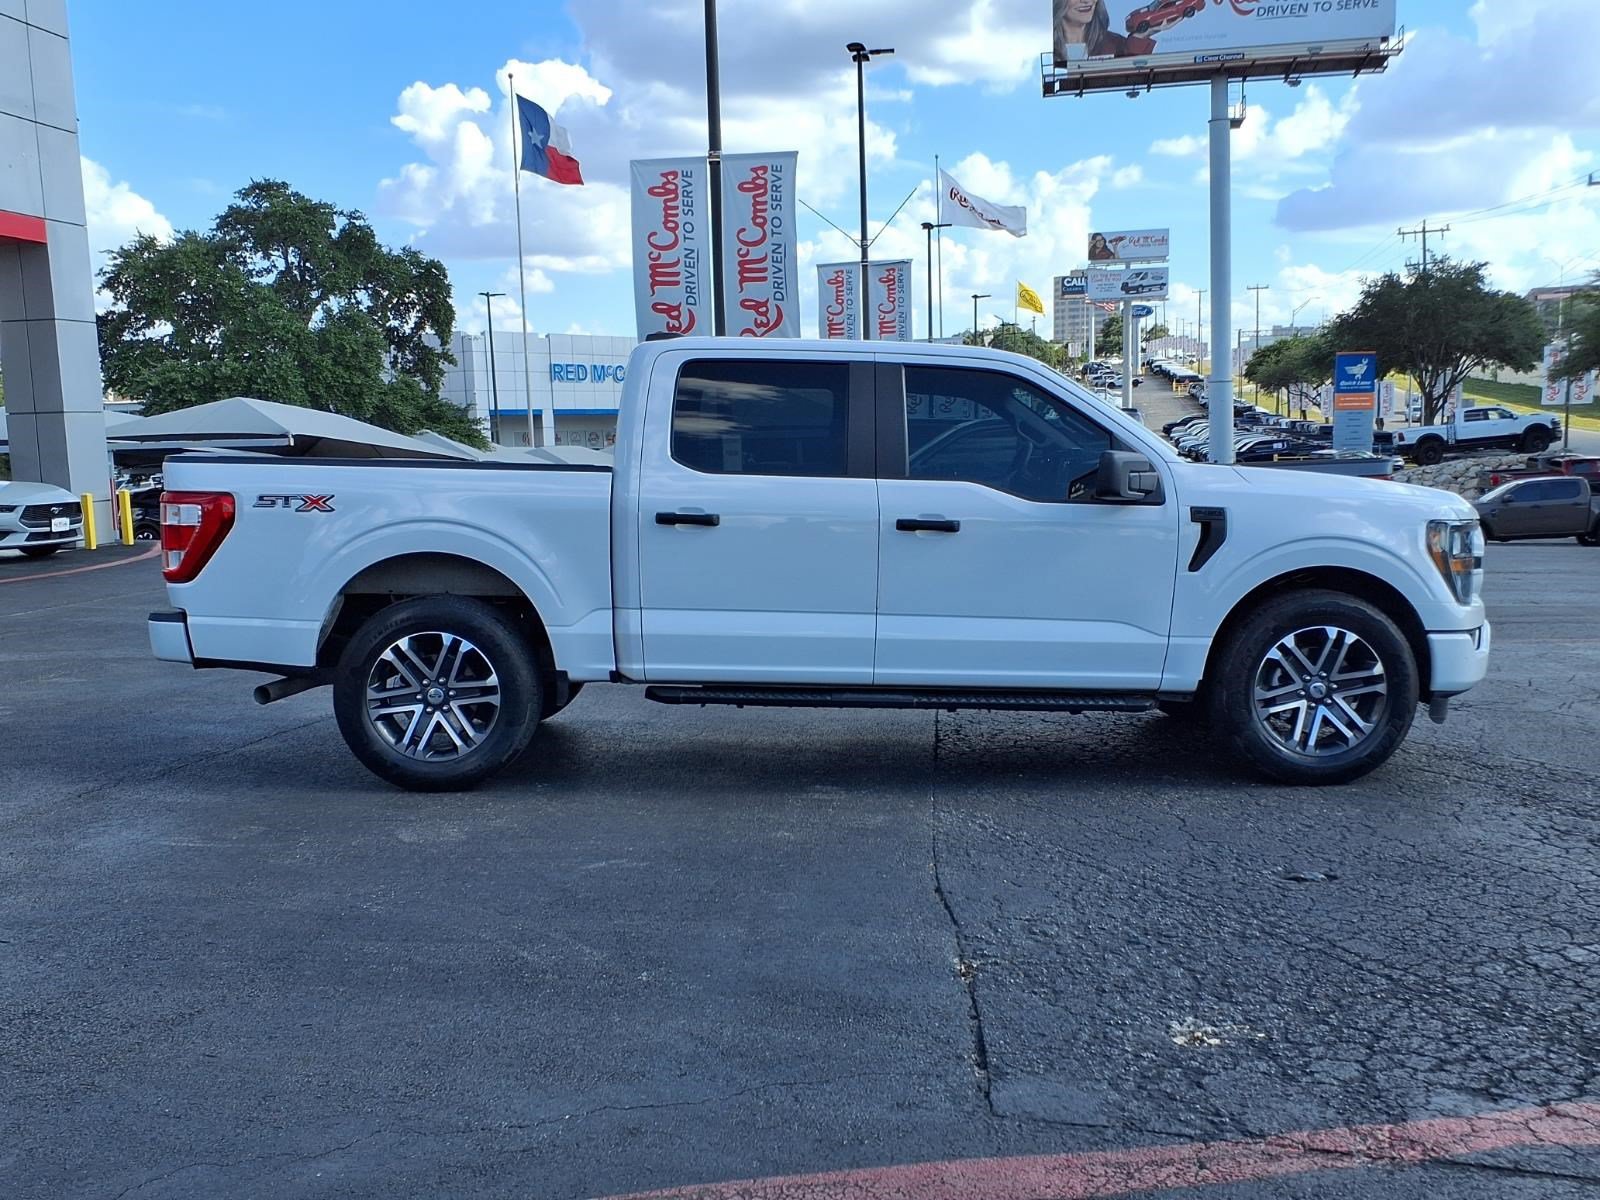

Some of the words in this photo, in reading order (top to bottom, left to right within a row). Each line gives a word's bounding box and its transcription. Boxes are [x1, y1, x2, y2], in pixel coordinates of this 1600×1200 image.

[1256, 2, 1309, 17] DRIVEN
[1314, 1, 1332, 13] TO
[1337, 0, 1379, 11] SERVE
[681, 170, 694, 217] SERVE
[770, 164, 782, 212] SERVE
[647, 170, 681, 297] McCombs
[683, 221, 695, 243] TO
[736, 165, 769, 294] McCombs
[771, 216, 783, 238] TO
[684, 247, 697, 306] DRIVEN
[772, 243, 785, 302] DRIVEN
[845, 269, 853, 296] SERVE
[897, 265, 905, 294] SERVE
[651, 301, 696, 335] ed
[826, 269, 845, 339] McCombs
[846, 298, 854, 311] TO
[878, 267, 897, 340] McCombs
[897, 297, 905, 311] TO
[846, 313, 854, 340] RIVEN
[552, 363, 588, 382] RED
[252, 494, 336, 513] STX
